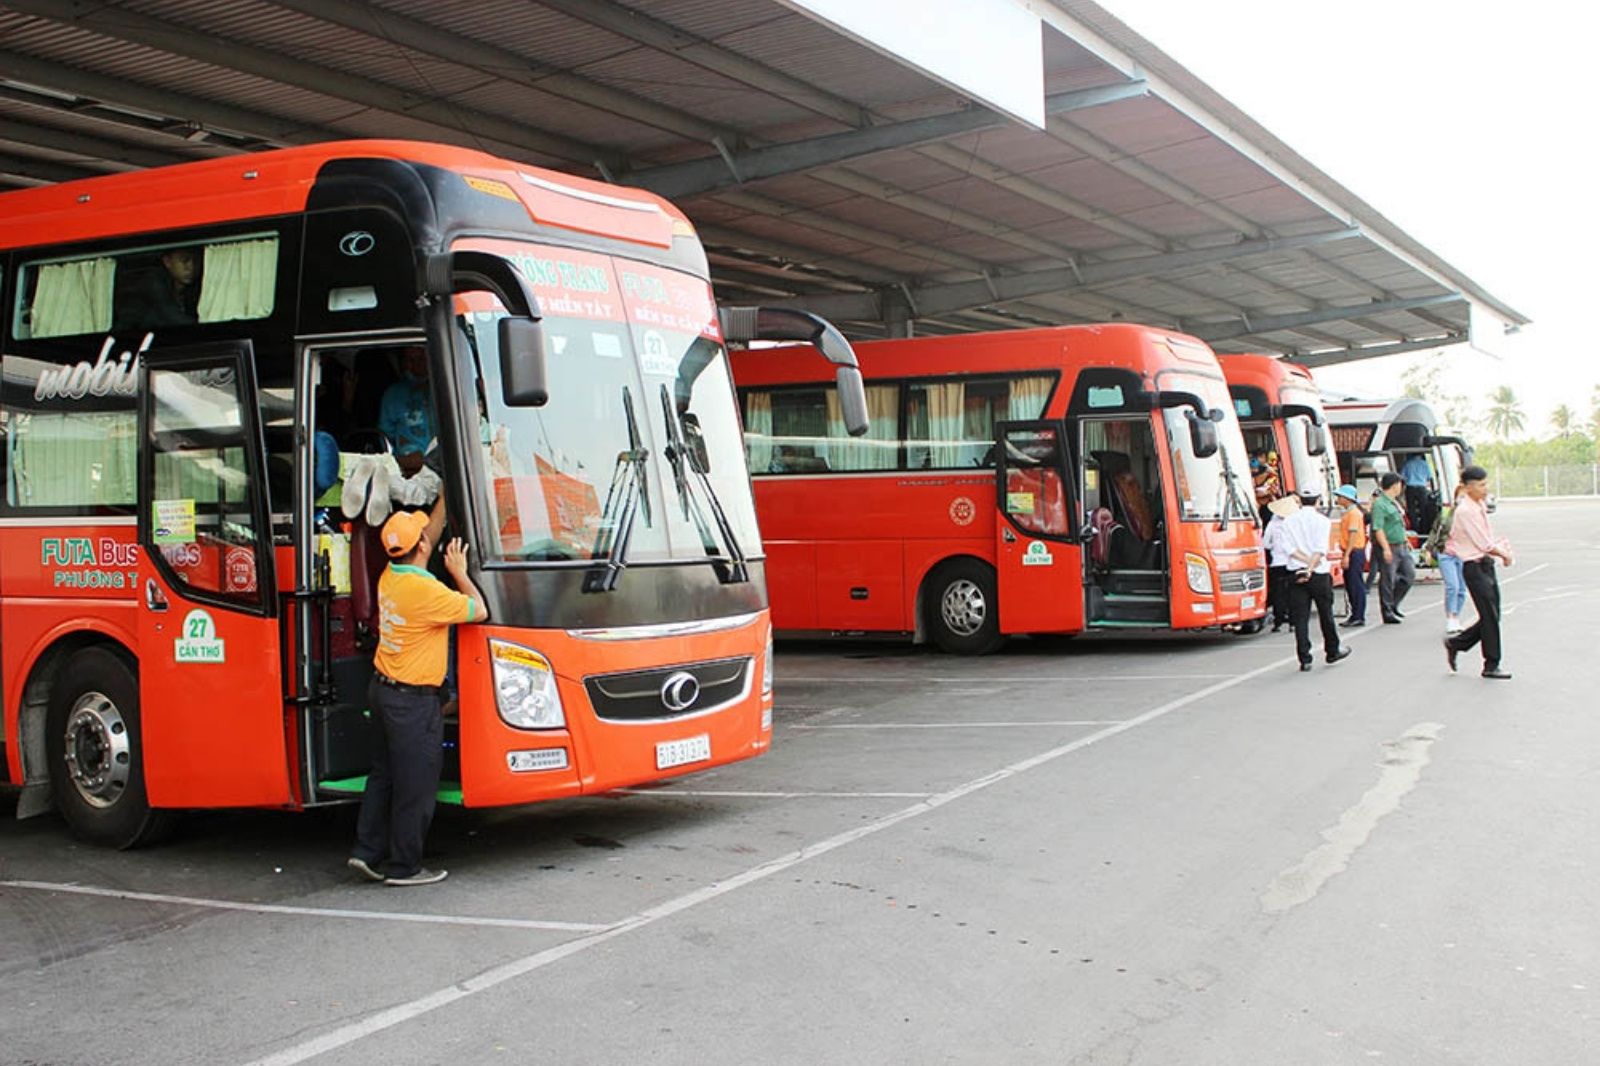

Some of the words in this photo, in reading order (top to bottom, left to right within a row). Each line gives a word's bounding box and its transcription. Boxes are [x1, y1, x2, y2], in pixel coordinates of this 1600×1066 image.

[646, 336, 661, 354] 27
[42, 537, 97, 566] FUTA
[54, 569, 125, 588] PHƯƠNG
[189, 618, 207, 638] 27
[178, 643, 198, 658] CẦN
[200, 643, 220, 657] THƠ
